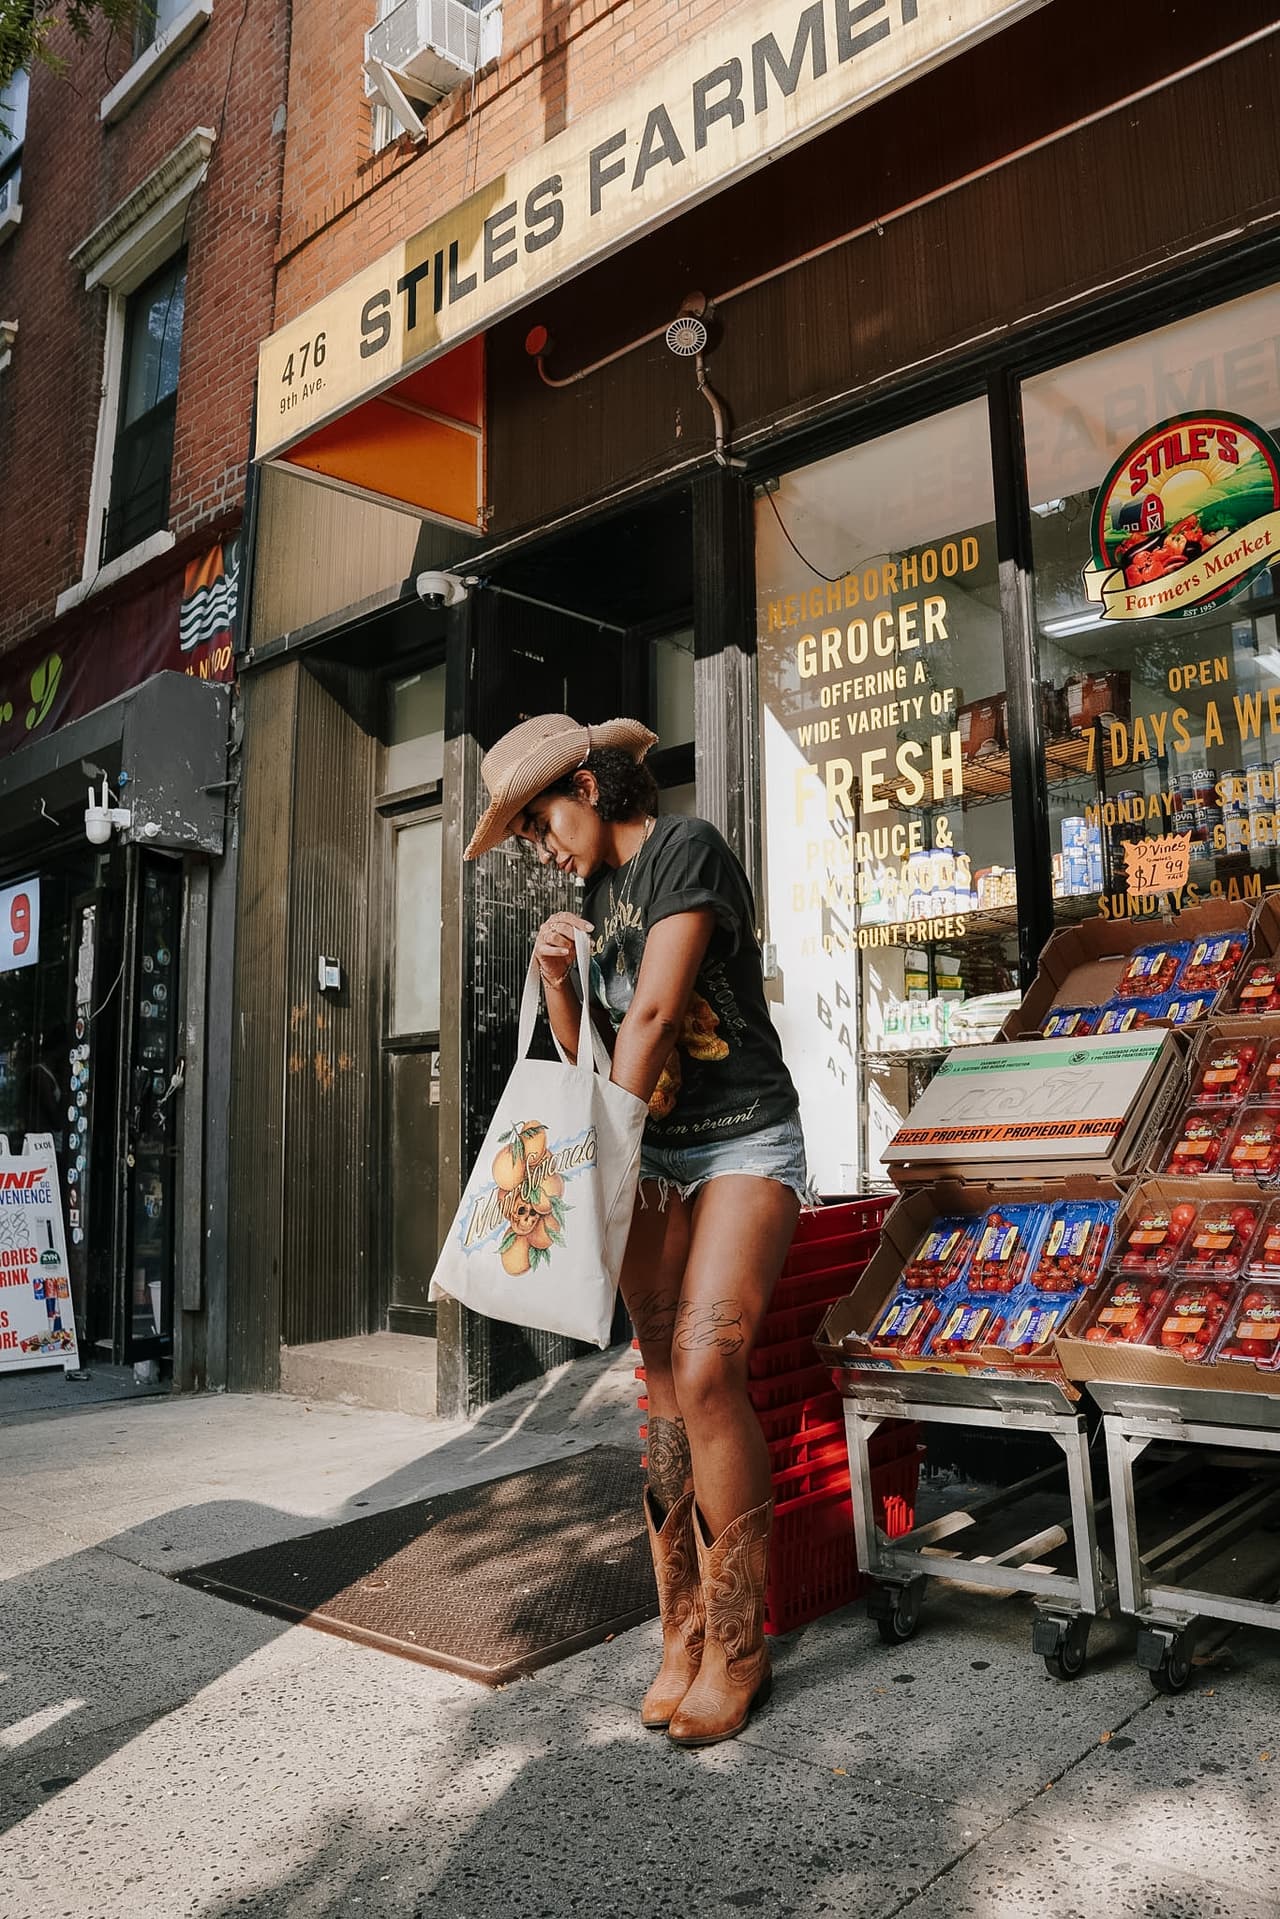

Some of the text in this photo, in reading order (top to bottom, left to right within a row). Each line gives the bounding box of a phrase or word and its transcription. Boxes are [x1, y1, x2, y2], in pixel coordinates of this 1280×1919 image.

[360, 0, 918, 359] STILES FARME
[281, 332, 326, 386] 476
[280, 378, 326, 414] 9th Ave.
[1129, 428, 1239, 496] STILE'S
[767, 536, 980, 633] NEIGHBORHOOD
[1125, 529, 1272, 611] Farmers Market
[797, 595, 949, 679] GROCER
[1183, 607, 1198, 617] EST
[820, 661, 926, 709] OFFERING A
[1168, 656, 1229, 692] OPEN
[798, 688, 954, 748] WIDE VARIETY OF
[1081, 727, 1096, 773] 7
[1110, 707, 1192, 767] DAYS
[1205, 701, 1224, 748] A
[794, 730, 963, 827] FRESH
[1085, 792, 1174, 826] MONDAY
[807, 816, 953, 871] PRODUCE &
[905, 915, 966, 943] PRICES
[930, 1128, 991, 1142] PROPERTY
[1002, 1123, 1076, 1138] PROPIEDAD
